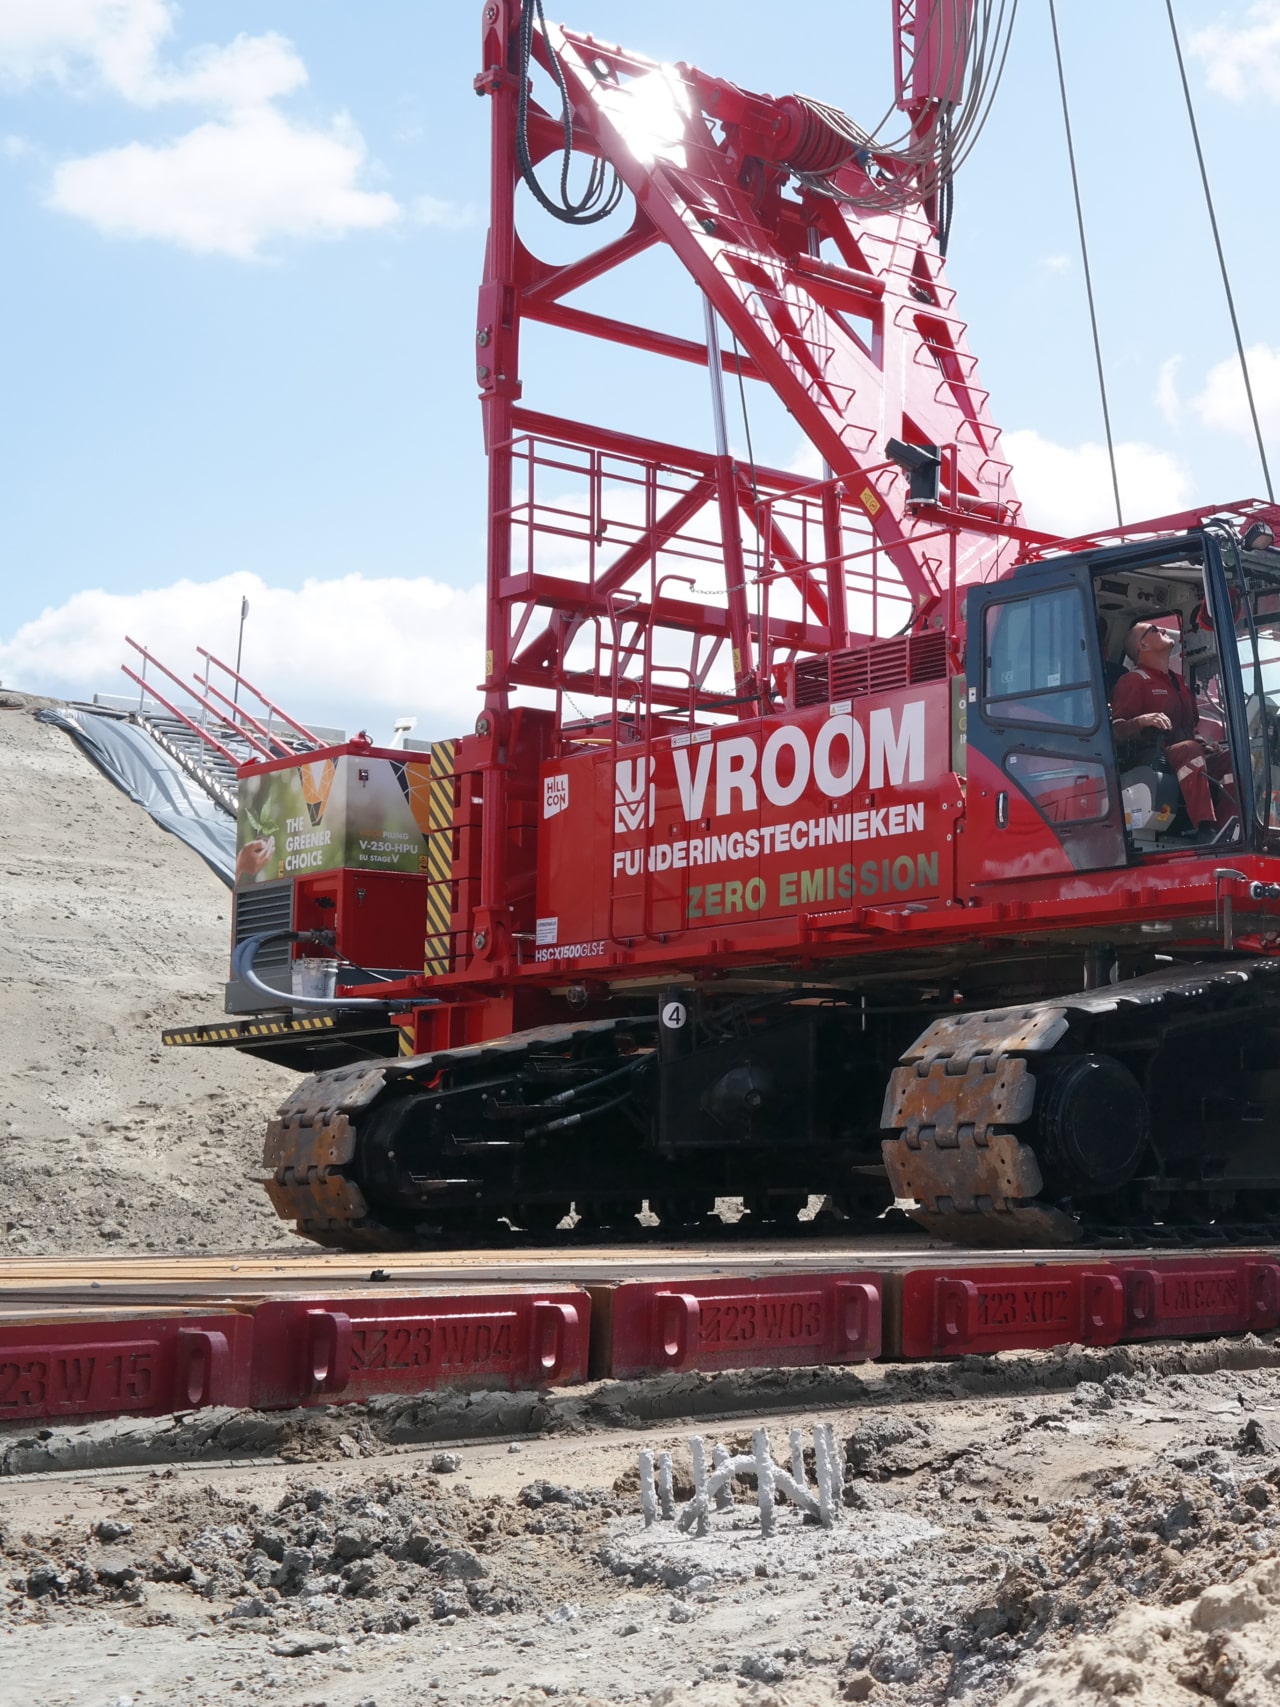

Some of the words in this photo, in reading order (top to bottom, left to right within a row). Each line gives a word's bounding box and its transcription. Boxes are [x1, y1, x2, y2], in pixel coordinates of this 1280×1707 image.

[672, 700, 925, 822] VROOM
[547, 778, 566, 794] HILL
[546, 793, 566, 808] CON
[286, 816, 304, 833] THE
[286, 830, 331, 852] GREENER
[359, 839, 418, 854] V-250-HPU
[613, 802, 925, 878] FUNDERINGSTECHNIEKEN
[285, 850, 323, 871] CHOICE
[370, 855, 391, 863] STAGE
[391, 854, 400, 863] V
[687, 876, 767, 919] ZERO
[779, 851, 939, 907] EMISSION
[535, 941, 605, 962] HSCX1500GLS-E
[668, 1005, 681, 1025] 4
